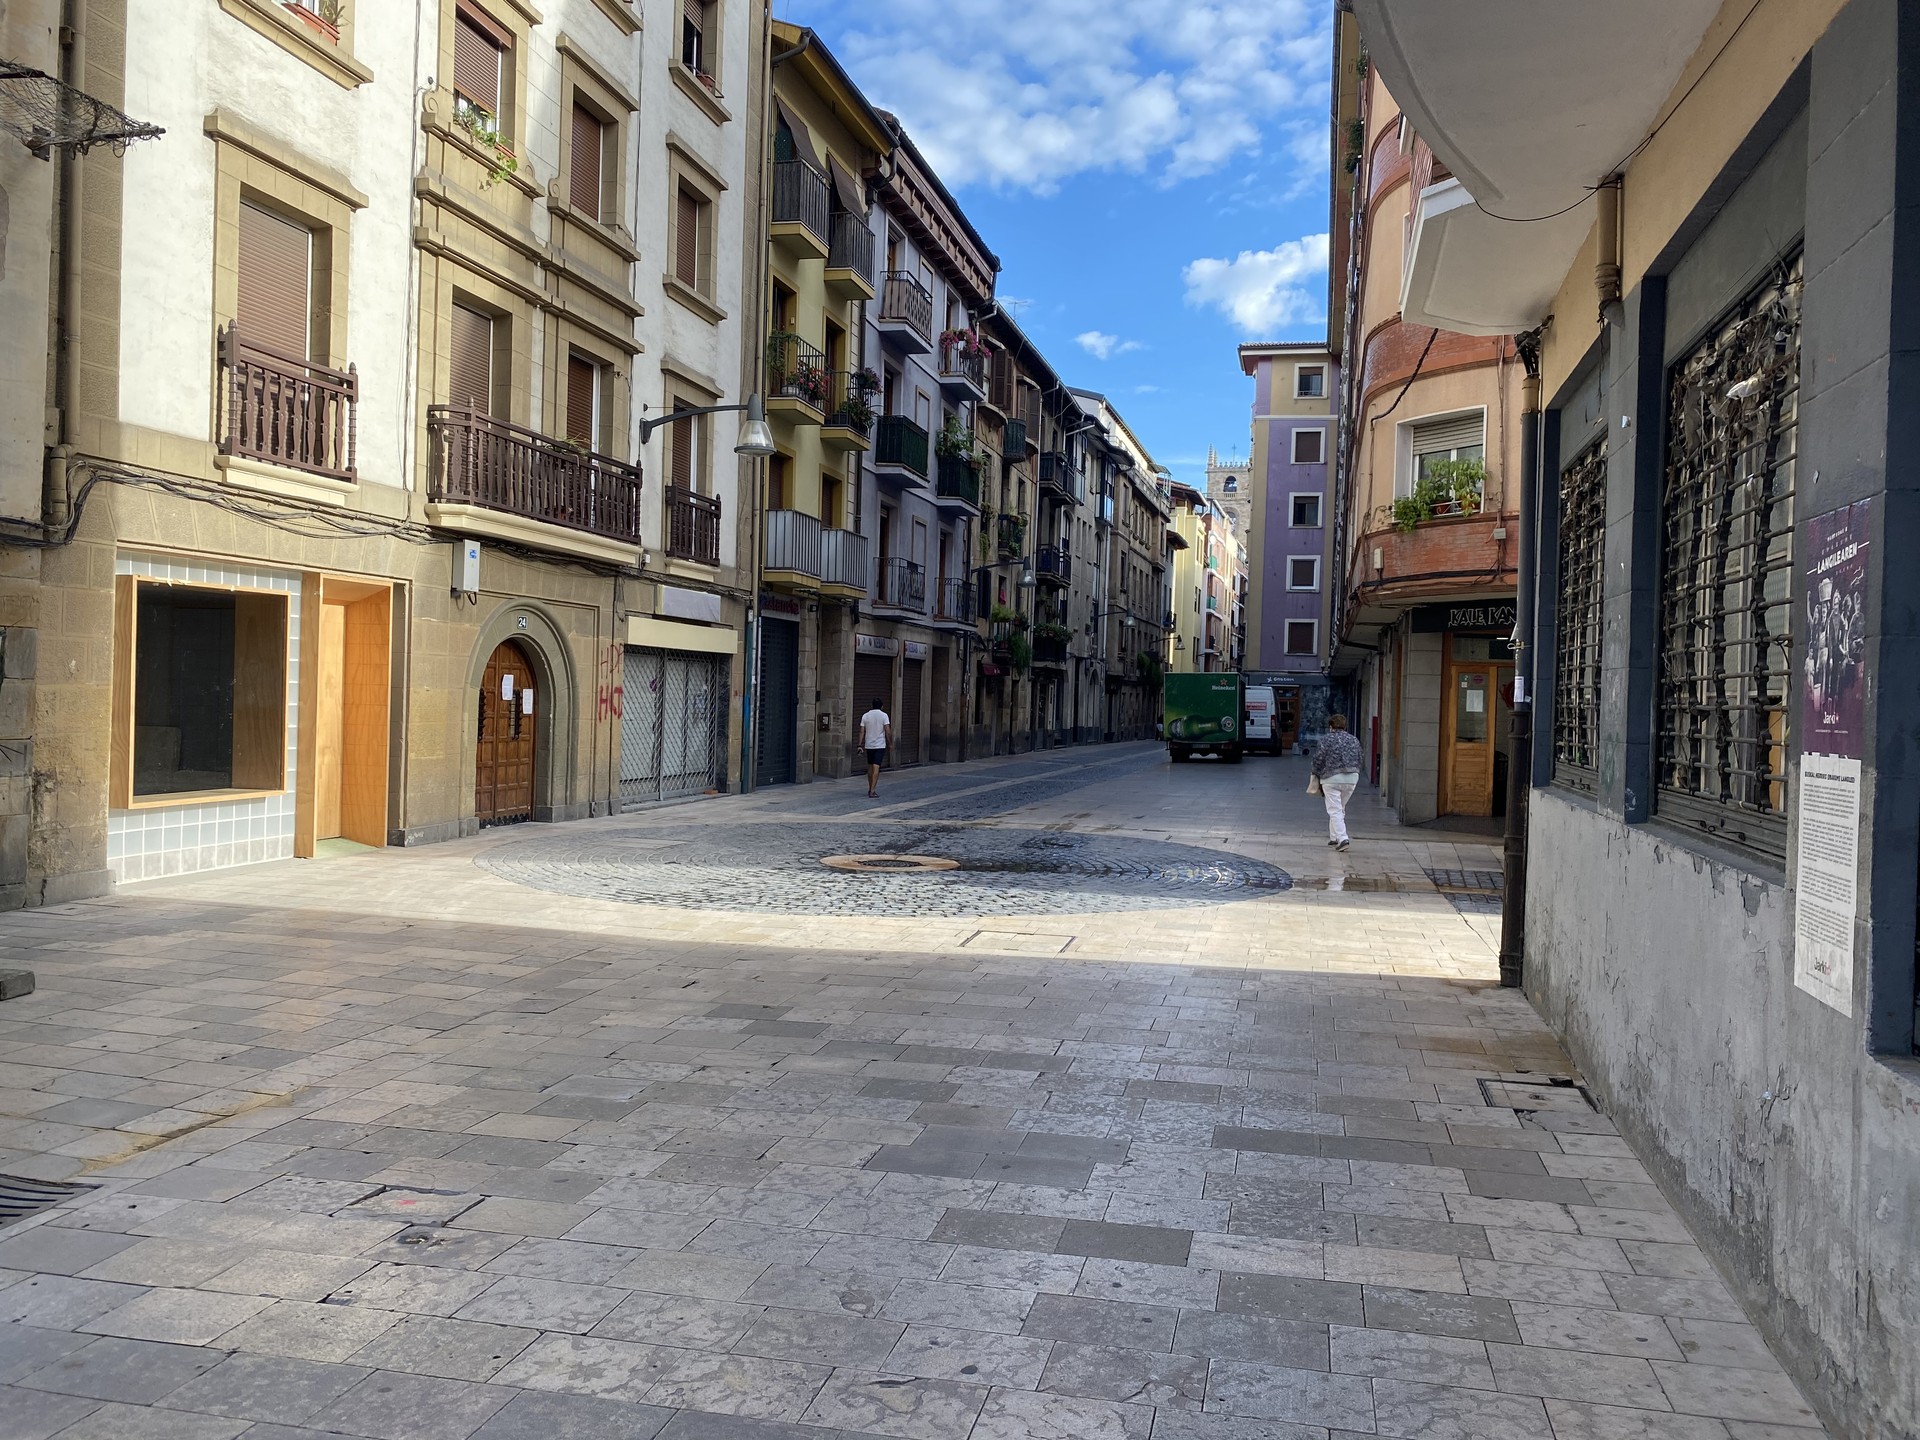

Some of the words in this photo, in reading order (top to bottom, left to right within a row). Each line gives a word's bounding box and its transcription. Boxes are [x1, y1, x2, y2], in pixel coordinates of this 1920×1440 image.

[1817, 541, 1858, 574] LANGILEAREN
[518, 617, 526, 628] 24
[1448, 608, 1487, 627] KALE
